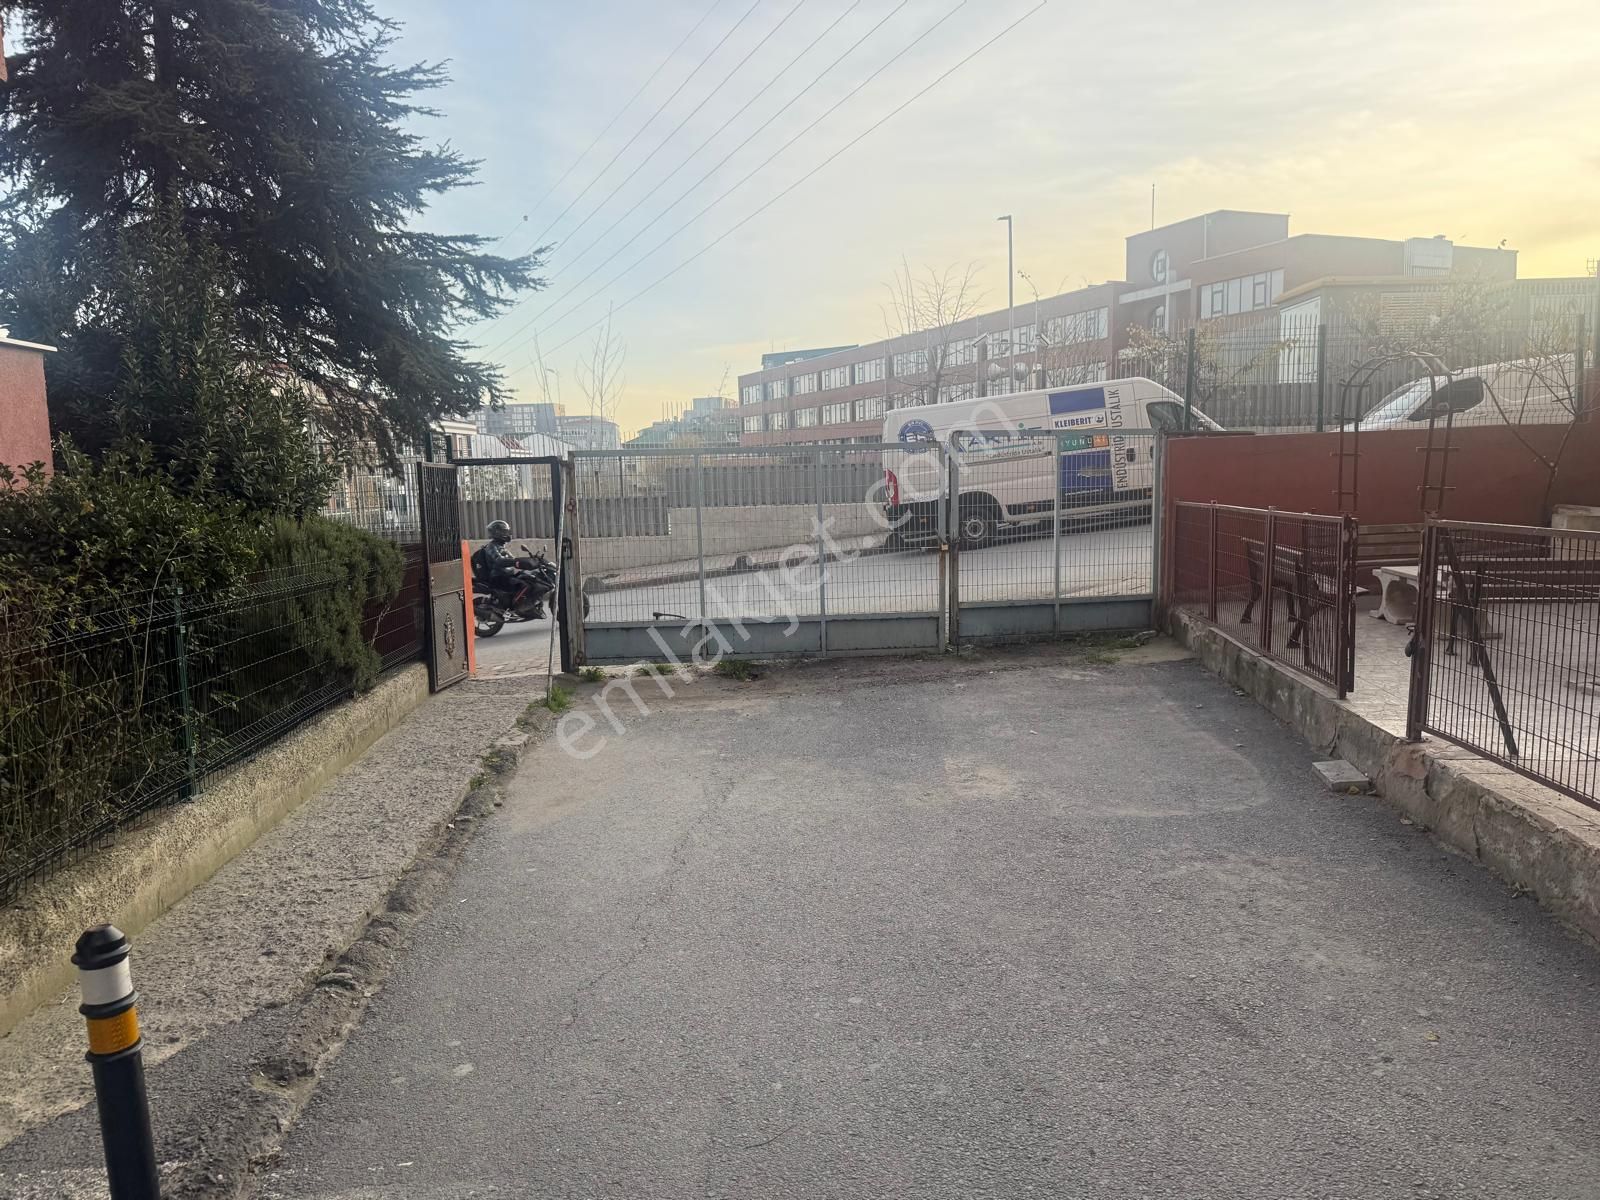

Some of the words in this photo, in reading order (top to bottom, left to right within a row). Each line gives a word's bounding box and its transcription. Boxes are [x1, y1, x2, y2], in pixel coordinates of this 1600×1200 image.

[1054, 416, 1092, 429] KLEIBERIT
[1107, 389, 1122, 428] USTALIK
[1112, 435, 1128, 489] ENDÜSTRİD
